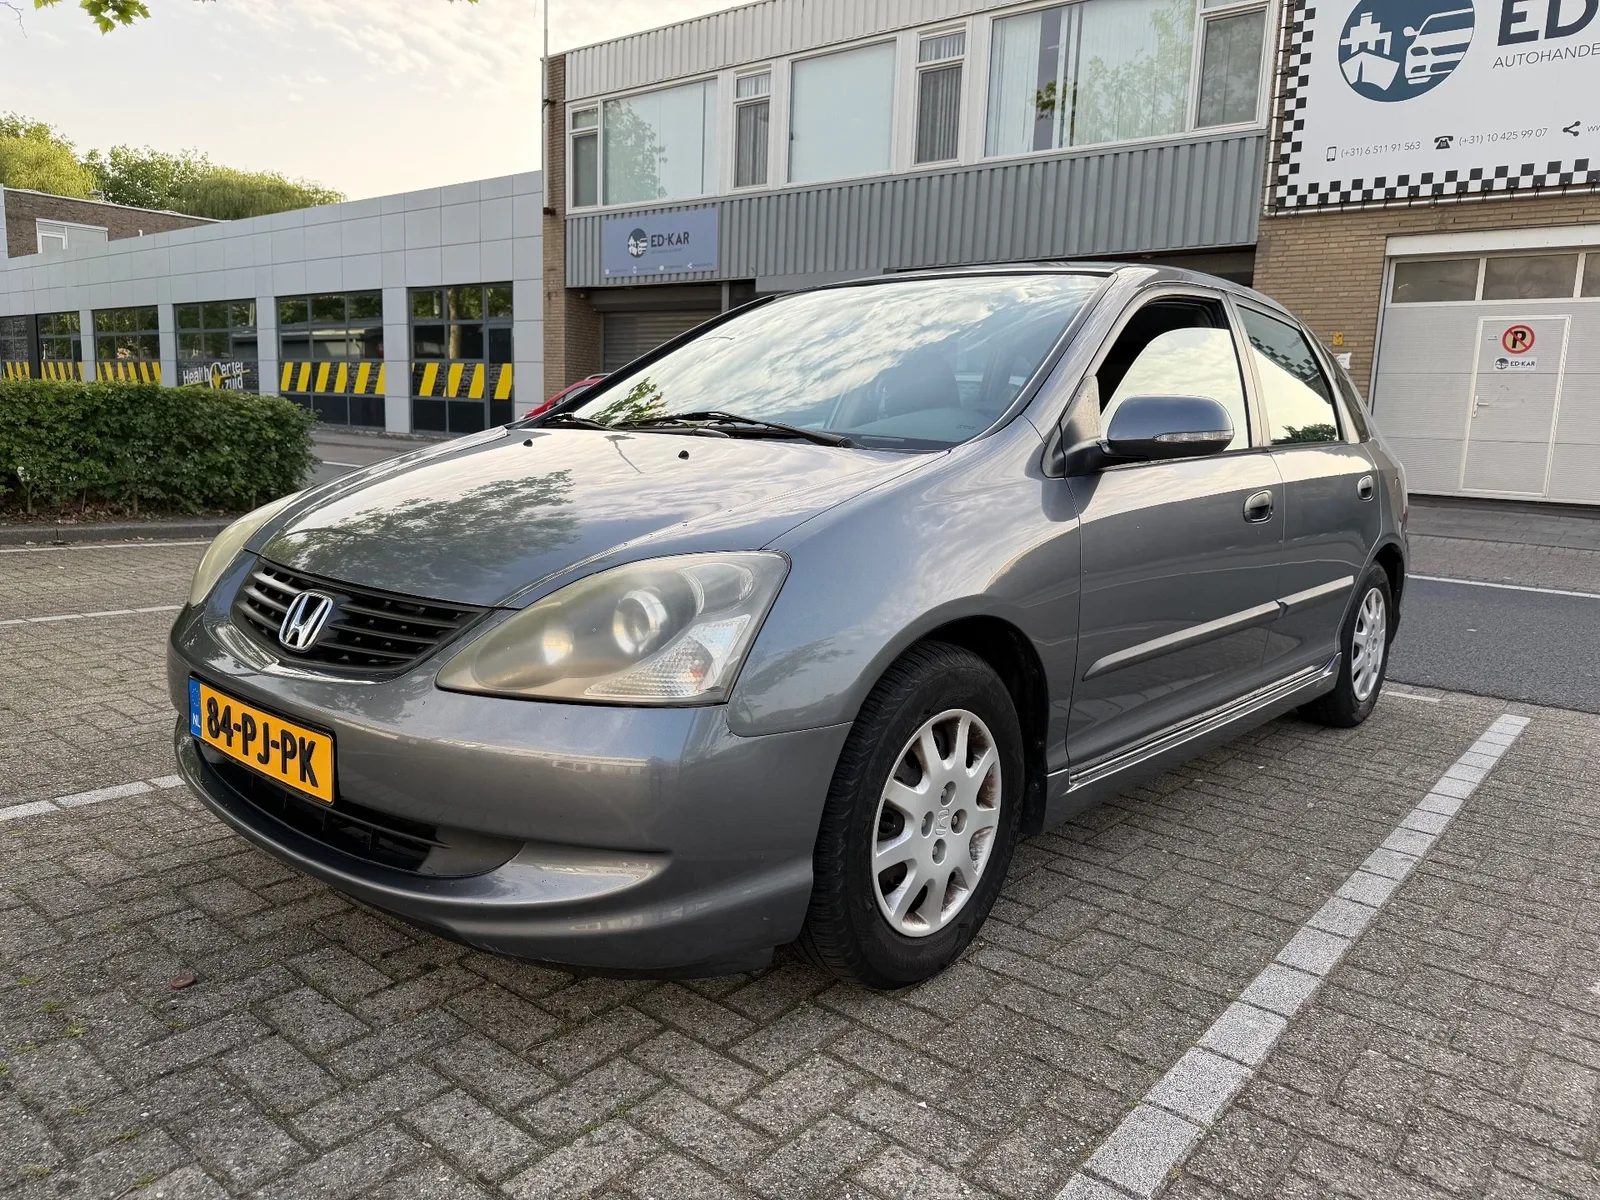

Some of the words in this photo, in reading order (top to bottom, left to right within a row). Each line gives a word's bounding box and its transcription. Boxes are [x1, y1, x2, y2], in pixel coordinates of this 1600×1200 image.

[1492, 42, 1600, 69] AUTOHANDE
[1458, 134, 1484, 146] (+31)
[1487, 132, 1499, 143] 10
[1500, 131, 1519, 141] 425
[1521, 129, 1534, 139] 99
[1535, 127, 1548, 137] 07
[1340, 147, 1363, 158] (+31)
[1364, 145, 1371, 155] 6
[1373, 144, 1388, 154] 511
[1391, 143, 1401, 152] 91
[1404, 141, 1421, 151] 563
[192, 712, 201, 728] NL
[207, 696, 319, 788] 84-PJ-PK
